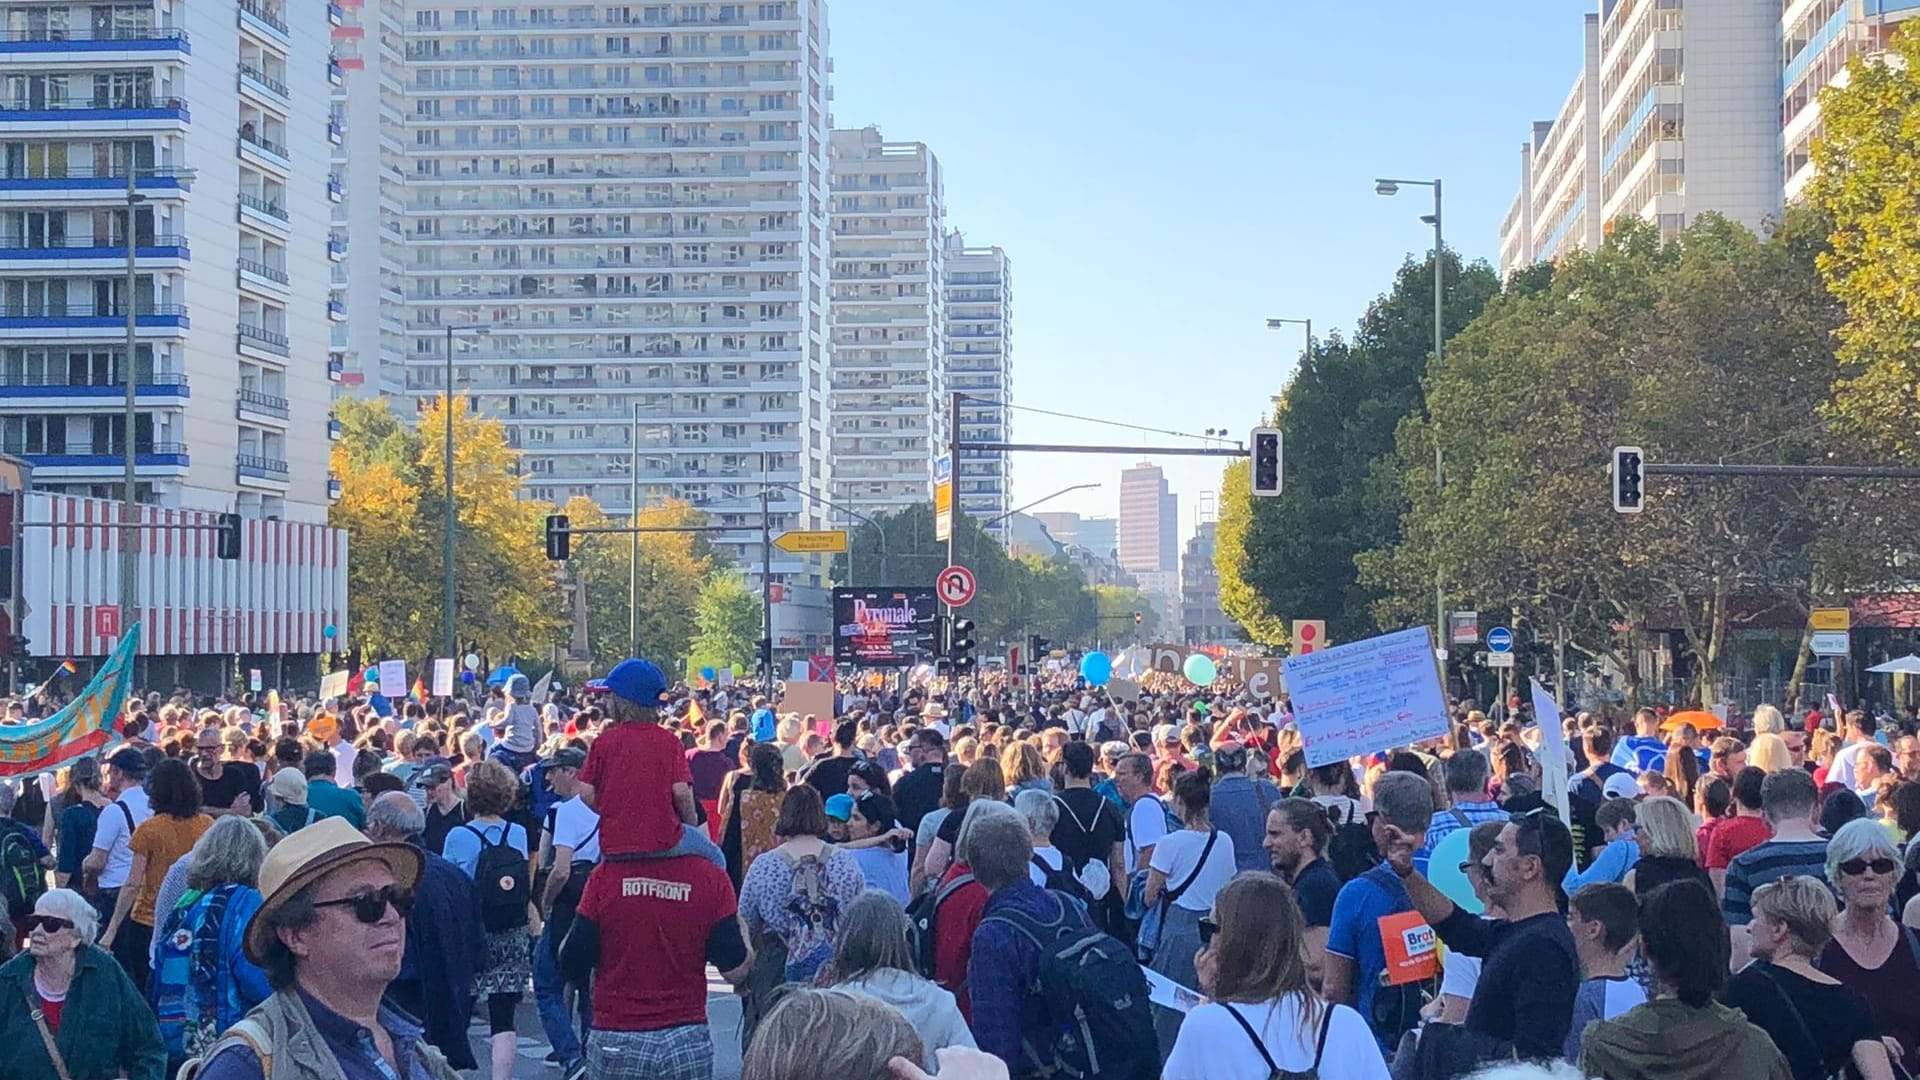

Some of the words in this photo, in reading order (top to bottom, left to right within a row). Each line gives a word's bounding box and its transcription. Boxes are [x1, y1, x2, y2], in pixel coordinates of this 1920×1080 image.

[854, 599, 917, 624] Pyronale
[622, 877, 692, 902] ROTFRONT
[1407, 929, 1433, 945] Brot
